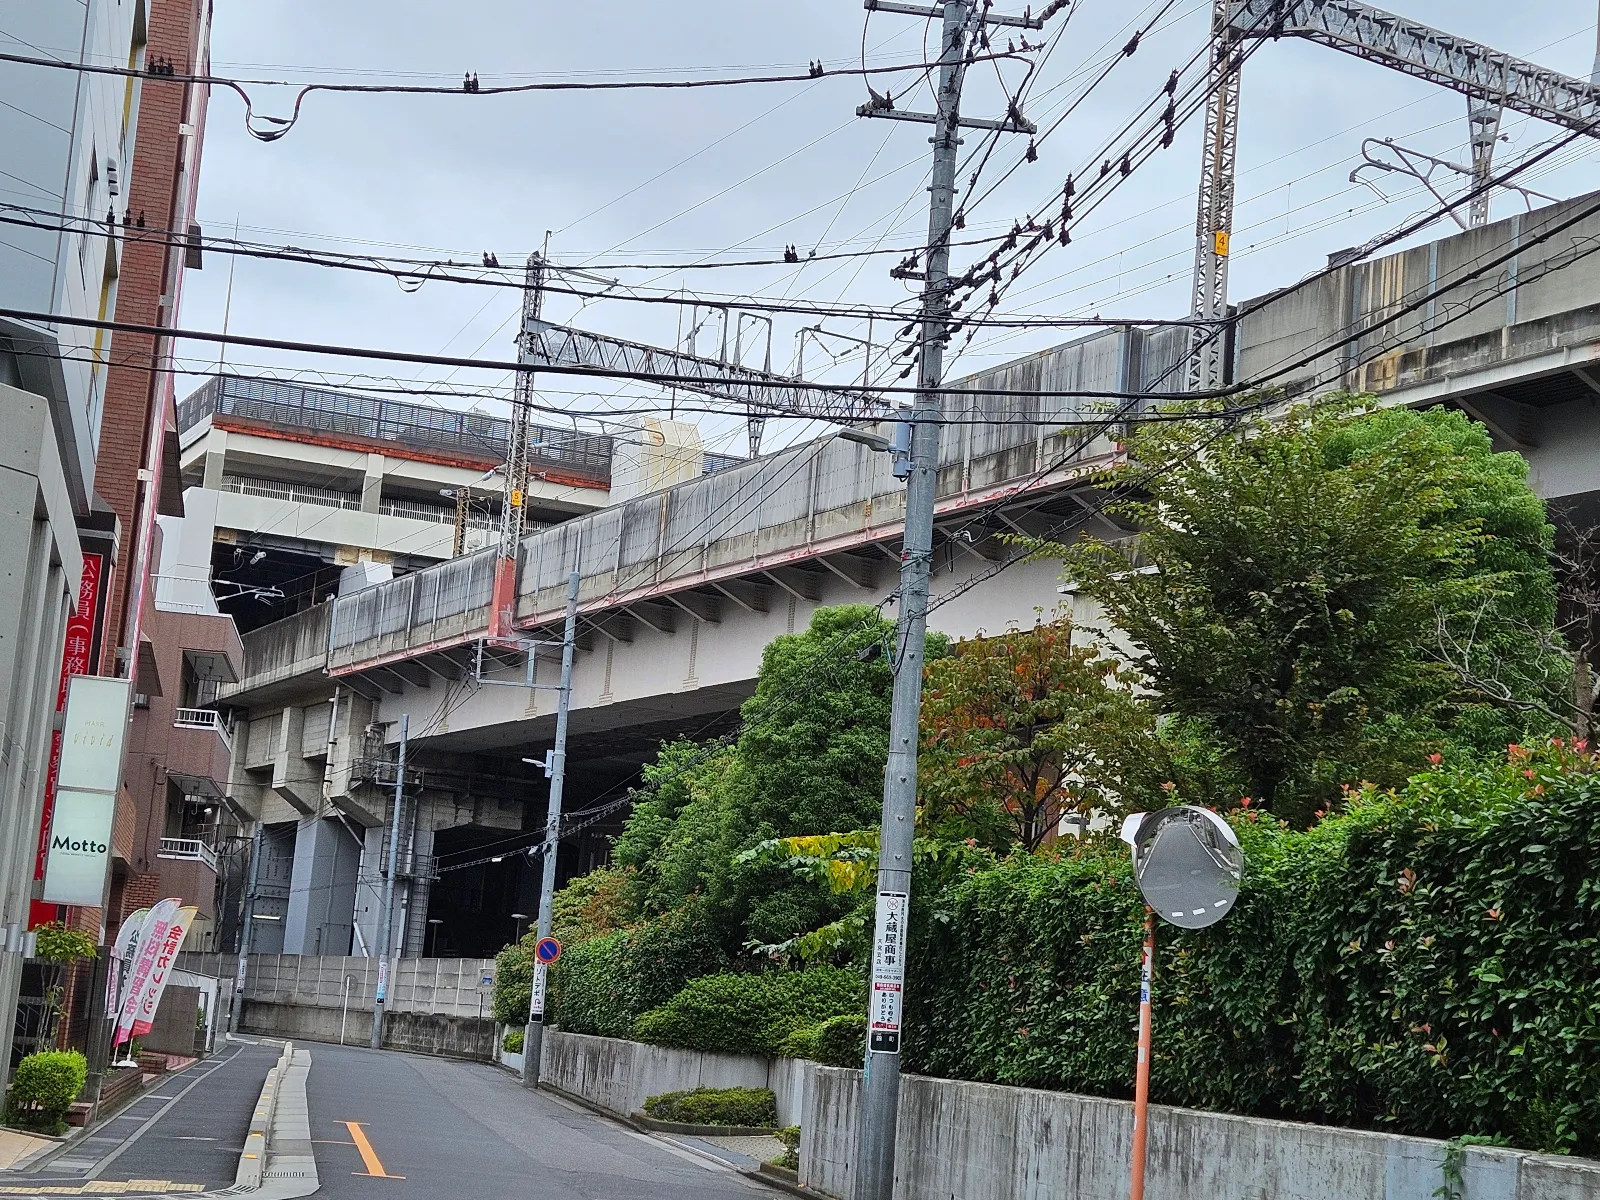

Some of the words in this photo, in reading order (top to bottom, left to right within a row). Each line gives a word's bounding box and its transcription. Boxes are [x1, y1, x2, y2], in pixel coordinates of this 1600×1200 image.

[1219, 236, 1225, 246] 4
[52, 836, 107, 854] Motto
[884, 911, 898, 966] 大蔵屋商事
[124, 919, 169, 1015] 無料講習会
[143, 925, 183, 1015] 会計カレッジ
